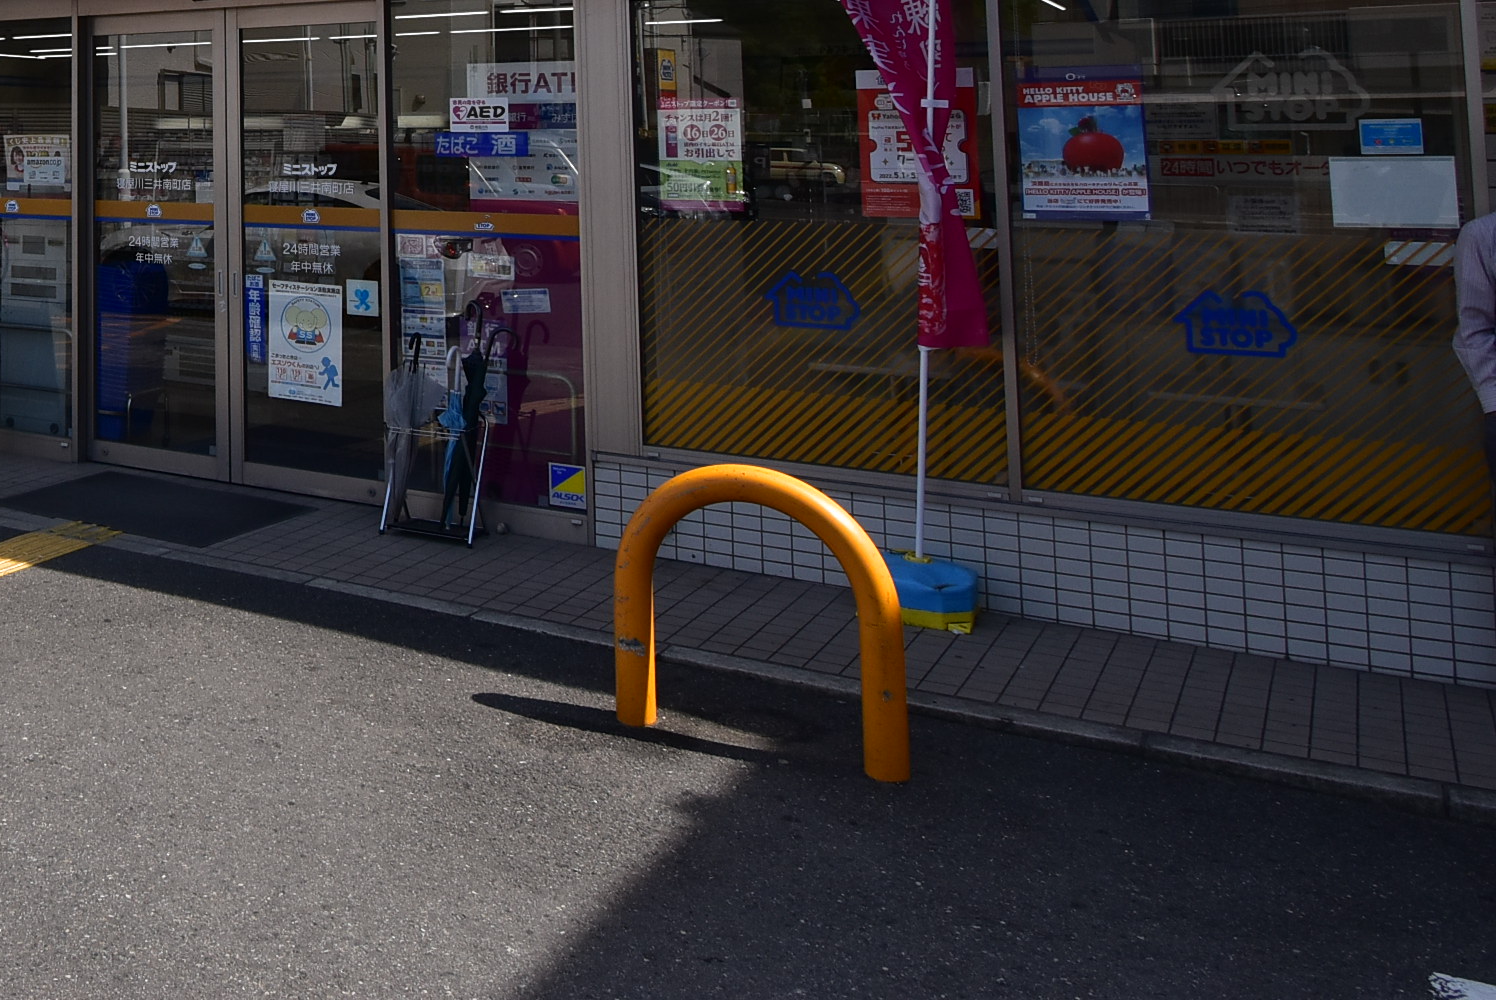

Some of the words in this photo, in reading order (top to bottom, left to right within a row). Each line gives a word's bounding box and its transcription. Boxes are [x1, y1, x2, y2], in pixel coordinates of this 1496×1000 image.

[487, 72, 576, 94] 銀行AT
[1022, 86, 1053, 95] HELLO
[1024, 93, 1064, 103] APPLE
[1068, 92, 1114, 102] HOUSE
[466, 105, 506, 119] AED
[436, 135, 479, 155] たばこ
[490, 134, 518, 156] 酒
[129, 161, 178, 173] ミニストップ
[283, 163, 338, 176] ミニストップ
[129, 235, 180, 248] 24時間営業
[282, 243, 341, 257] 24時間営業
[135, 252, 173, 265] 年中無休
[290, 261, 335, 274] 年中無休
[1200, 327, 1273, 348] STOP
[551, 491, 585, 503] ALSOK
